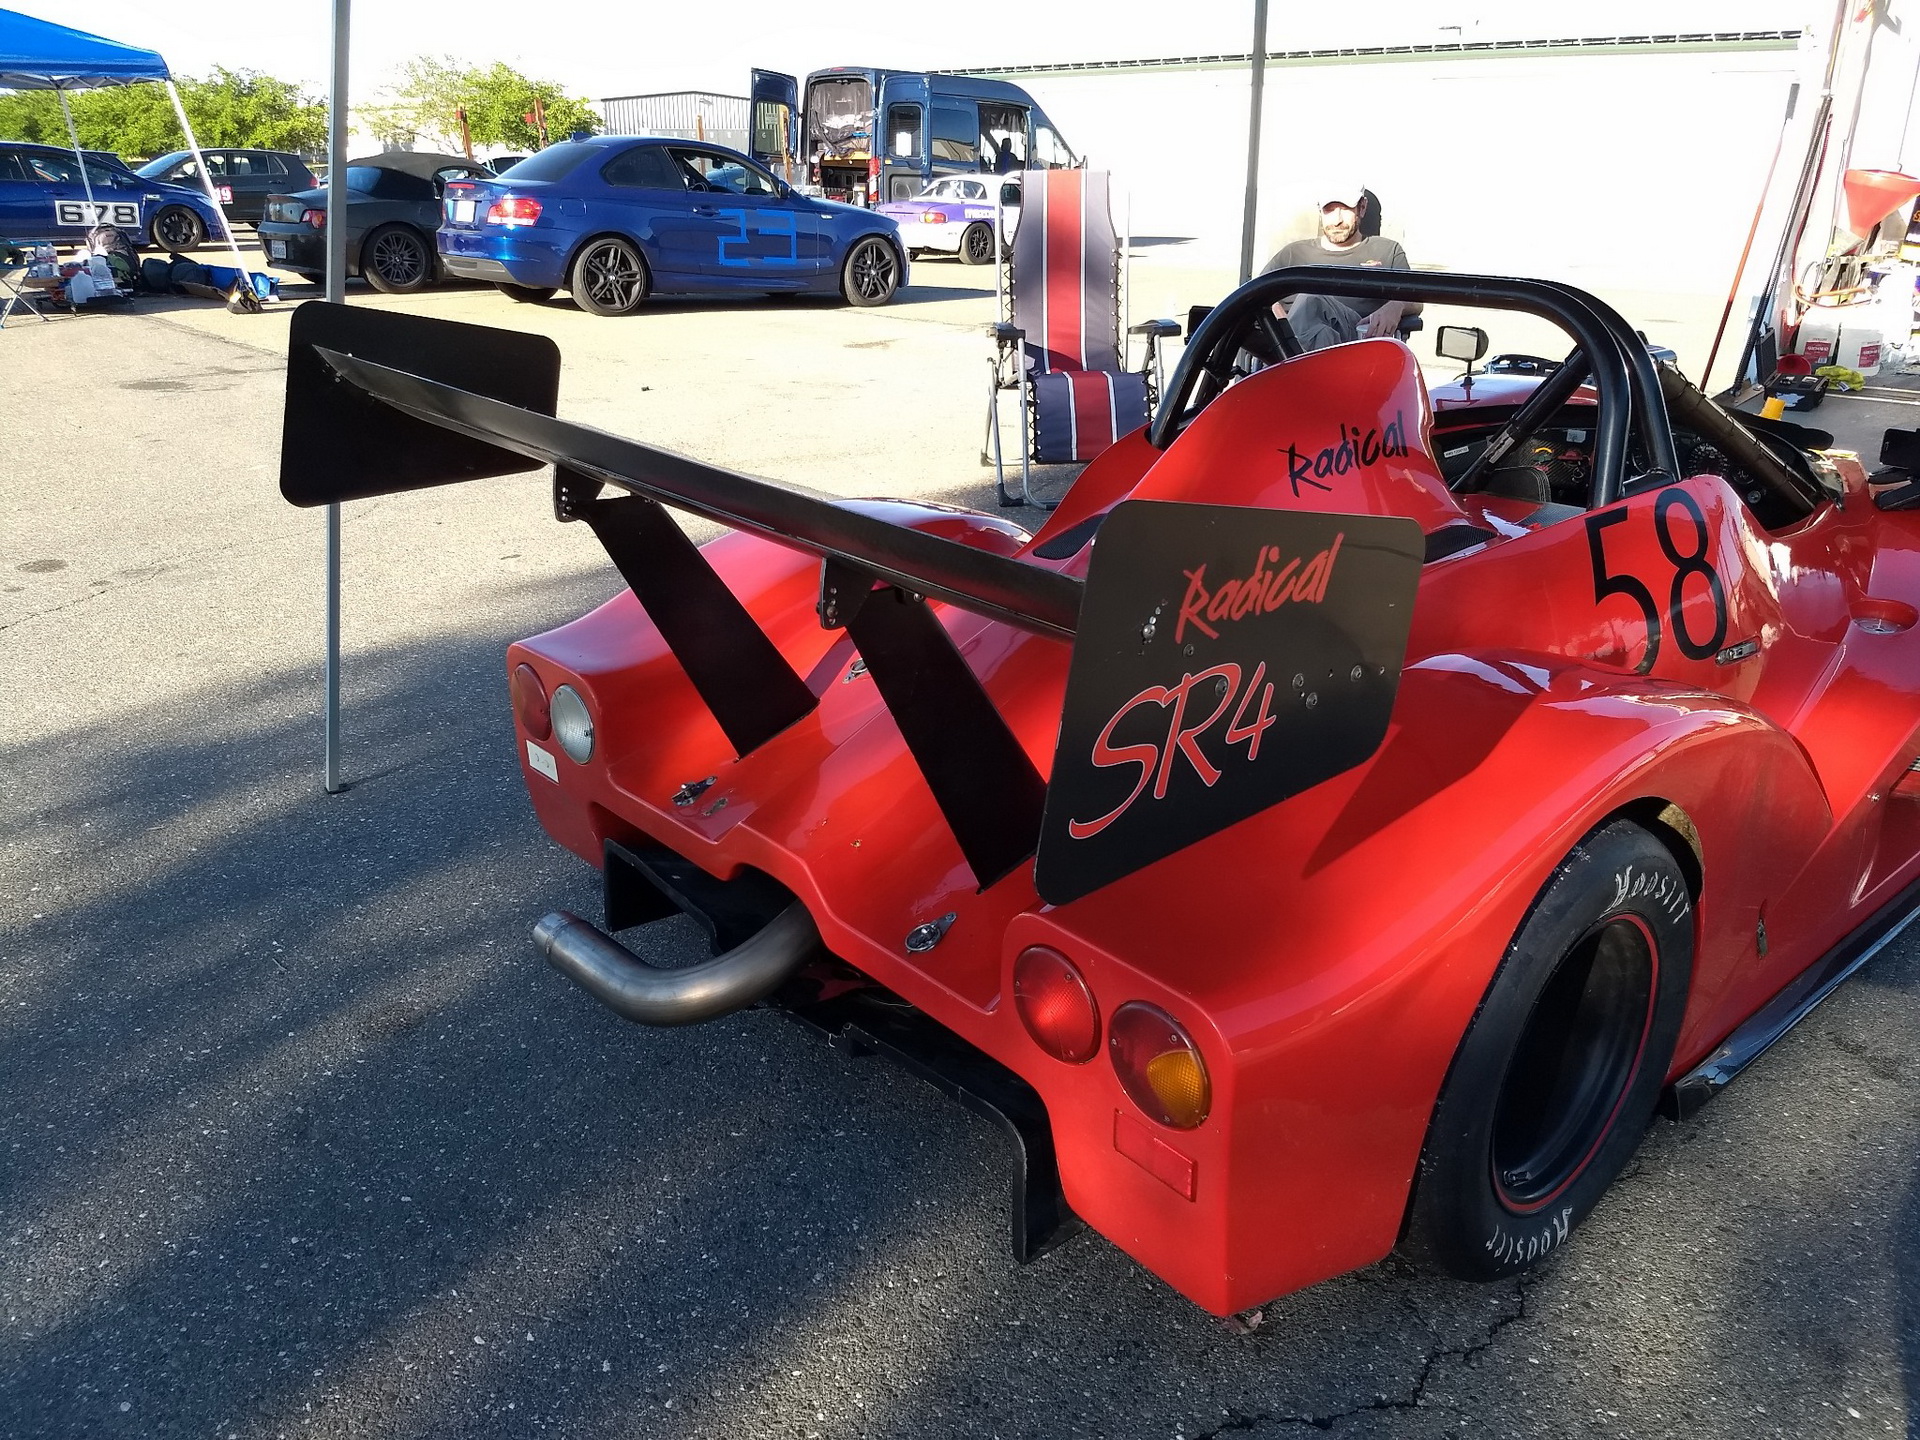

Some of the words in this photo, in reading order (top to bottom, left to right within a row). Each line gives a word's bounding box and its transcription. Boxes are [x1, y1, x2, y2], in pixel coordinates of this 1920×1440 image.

[57, 202, 137, 225] 678
[718, 208, 797, 267] 23
[1277, 410, 1409, 498] Radical
[1175, 533, 1345, 644] Radical
[1584, 488, 1728, 676] 58
[1069, 661, 1277, 839] SR4
